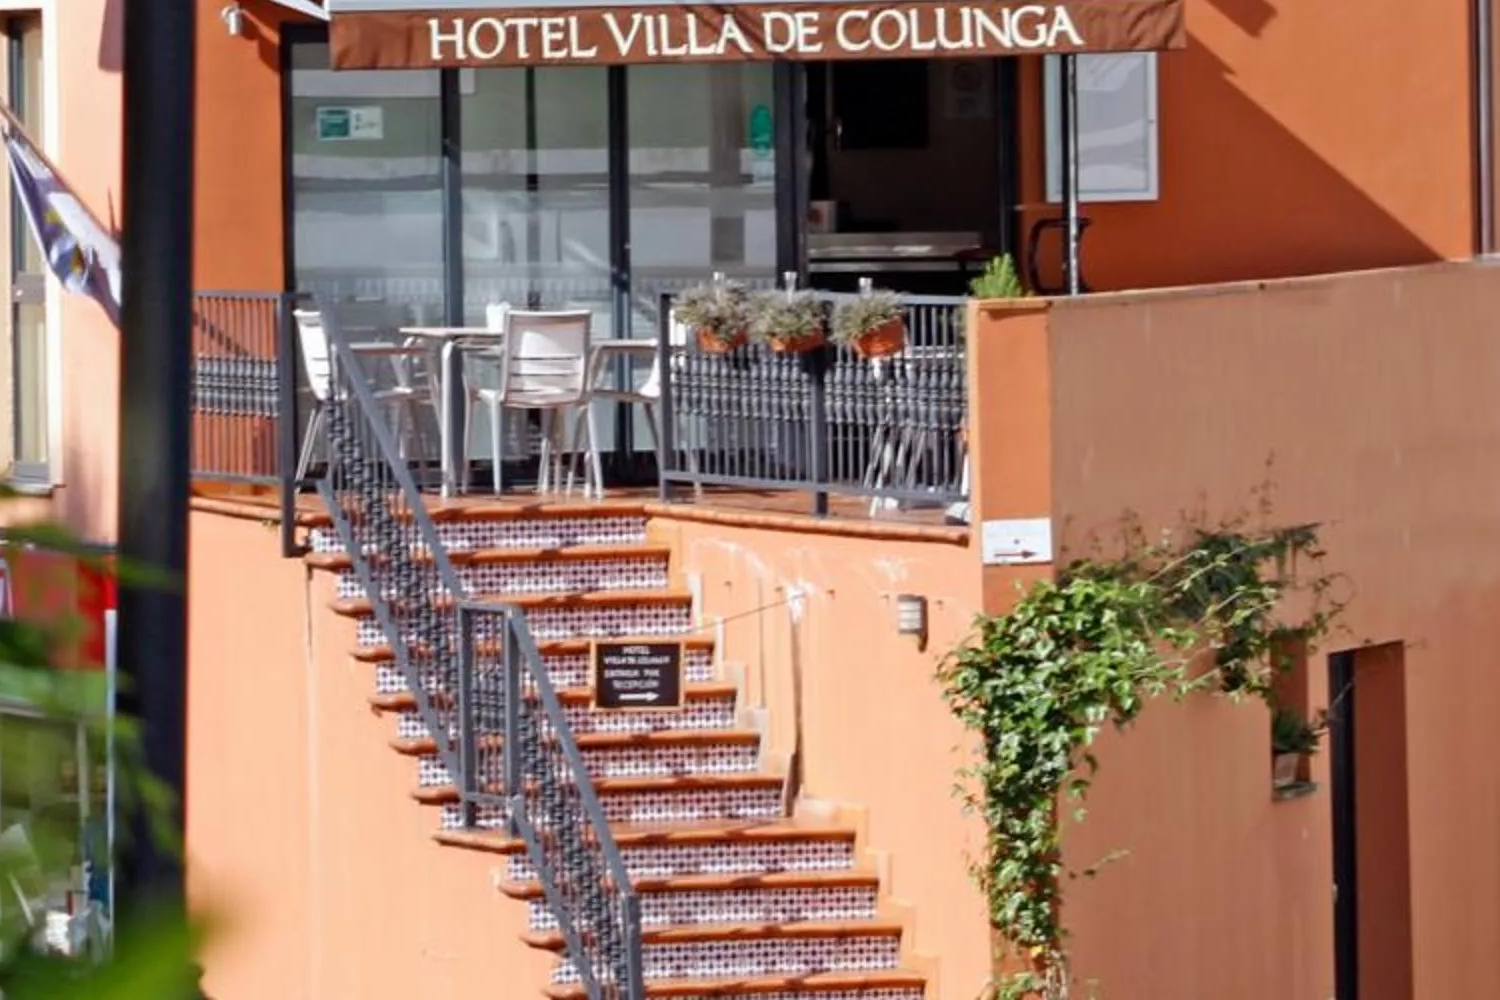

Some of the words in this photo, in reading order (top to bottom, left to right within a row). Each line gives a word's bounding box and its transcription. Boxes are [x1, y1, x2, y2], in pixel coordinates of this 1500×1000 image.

[427, 14, 599, 61] HOTEL
[602, 12, 754, 58] VILLA
[762, 10, 824, 54] DE
[834, 4, 1086, 52] COLUNGA
